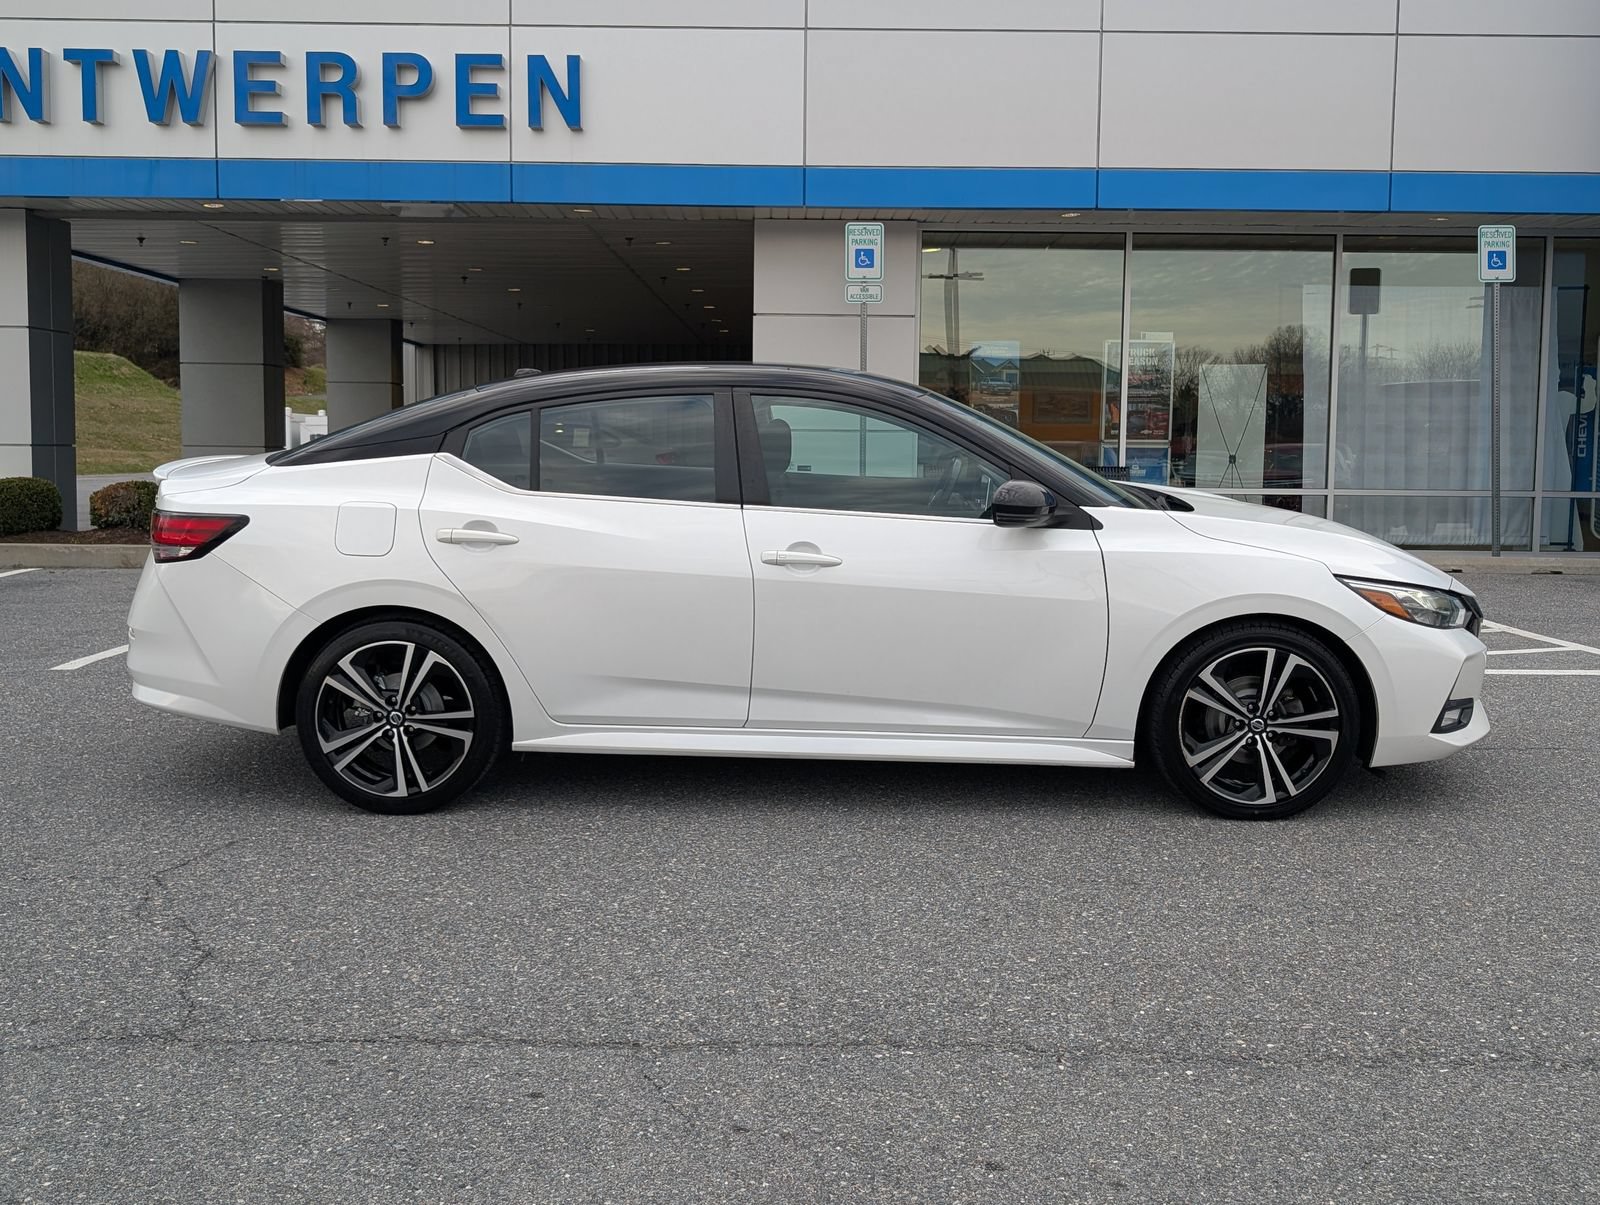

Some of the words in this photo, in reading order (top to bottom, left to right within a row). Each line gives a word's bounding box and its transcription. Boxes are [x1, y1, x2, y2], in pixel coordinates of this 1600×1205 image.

[0, 47, 583, 131] NTWERPEN
[849, 228, 880, 236] RESERVED
[851, 238, 878, 246] PARKING
[1129, 357, 1159, 366] EASON
